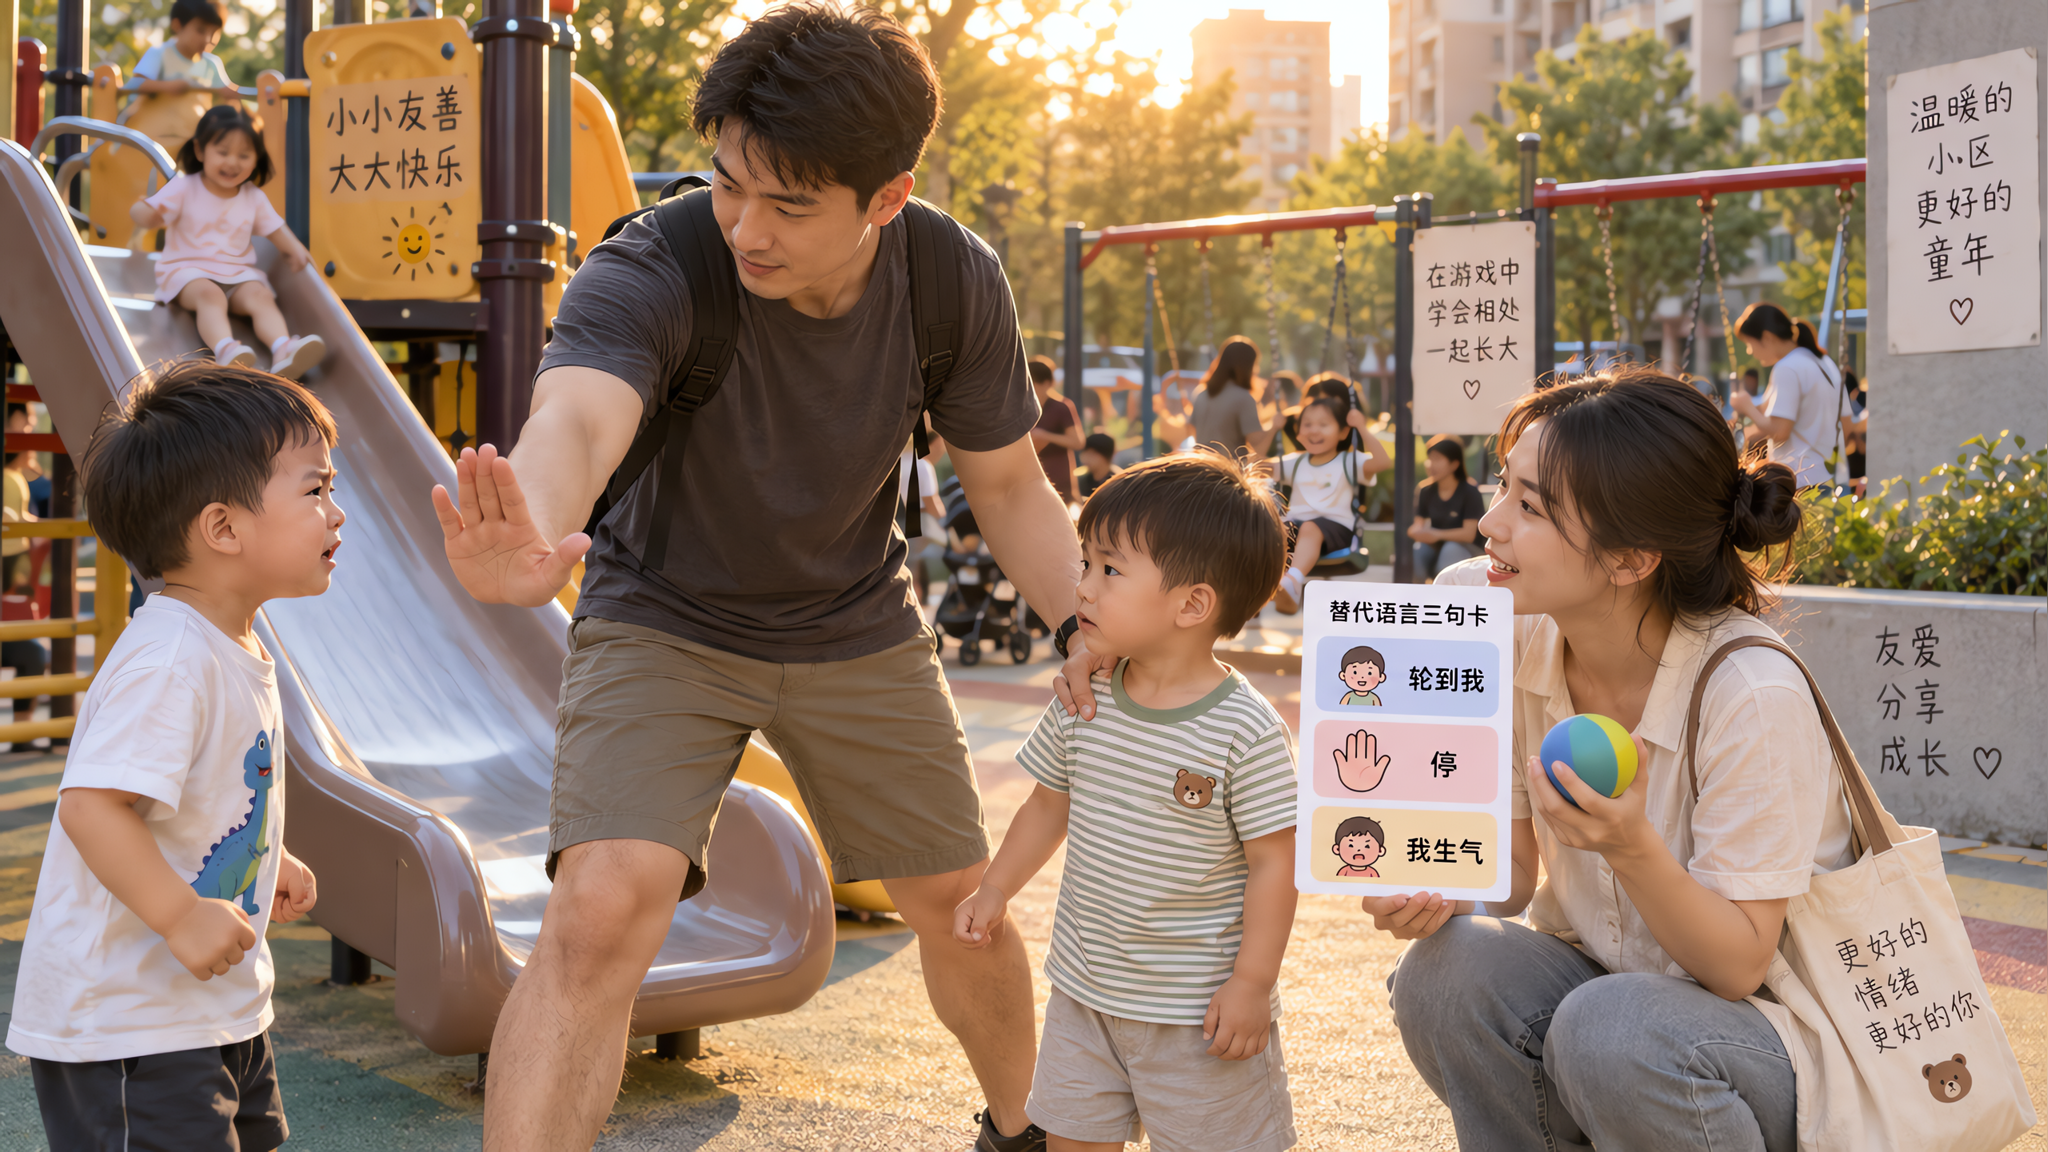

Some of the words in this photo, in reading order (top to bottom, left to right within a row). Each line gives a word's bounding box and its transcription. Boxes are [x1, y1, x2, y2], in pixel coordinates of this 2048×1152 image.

[327, 85, 462, 136] 小小友善
[1910, 81, 2012, 133] 温暖的
[329, 144, 462, 194] 大大快乐
[1928, 134, 1994, 175] 小区
[1917, 179, 2011, 229] 更好的
[1426, 257, 1519, 289] 在游戏中
[1923, 233, 1994, 282] 童年
[1428, 297, 1519, 327] 学会相处
[1426, 335, 1518, 363] 一起长大
[1329, 599, 1489, 627] 替代语言三句卡
[1875, 624, 1941, 668] 友爱
[1408, 666, 1484, 693] 轮到我
[1877, 679, 1944, 724] 分享
[1430, 751, 1457, 778] 停
[1880, 736, 1949, 777] 成长
[1407, 837, 1484, 865] 我生气
[1835, 917, 1928, 973] 更好的
[1854, 966, 1919, 1012] 情绪
[1865, 990, 1980, 1054] 更好的你
